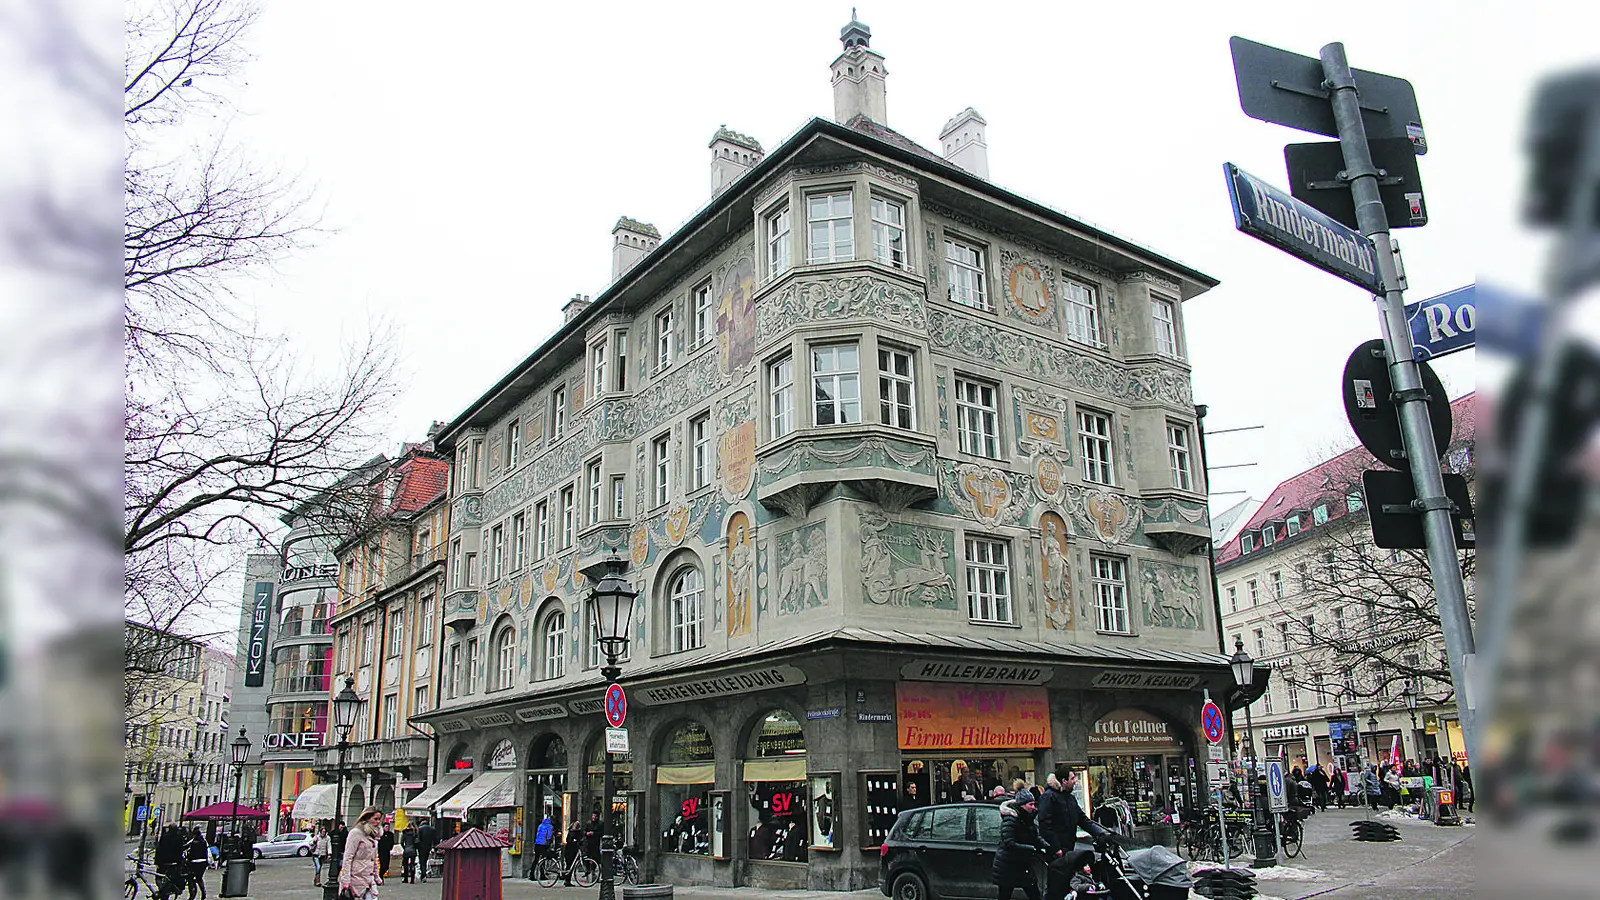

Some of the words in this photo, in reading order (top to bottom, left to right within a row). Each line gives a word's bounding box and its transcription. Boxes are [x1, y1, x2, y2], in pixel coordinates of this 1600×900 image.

[1254, 183, 1375, 276] Rindermarkt
[278, 562, 340, 584] KONE
[249, 592, 268, 675] KONEN
[920, 662, 1041, 681] HILLENBRAND
[1098, 673, 1141, 686] PHOTO
[1143, 673, 1196, 688] KELLNER
[647, 668, 785, 702] HERRENBEKLEIDUNG
[905, 726, 953, 746] Firma
[959, 726, 1046, 746] Hillenbrand
[1094, 720, 1121, 734] Foto
[1123, 720, 1168, 734] Kellner
[1262, 724, 1308, 739] TRETTER
[262, 732, 326, 748] KONE
